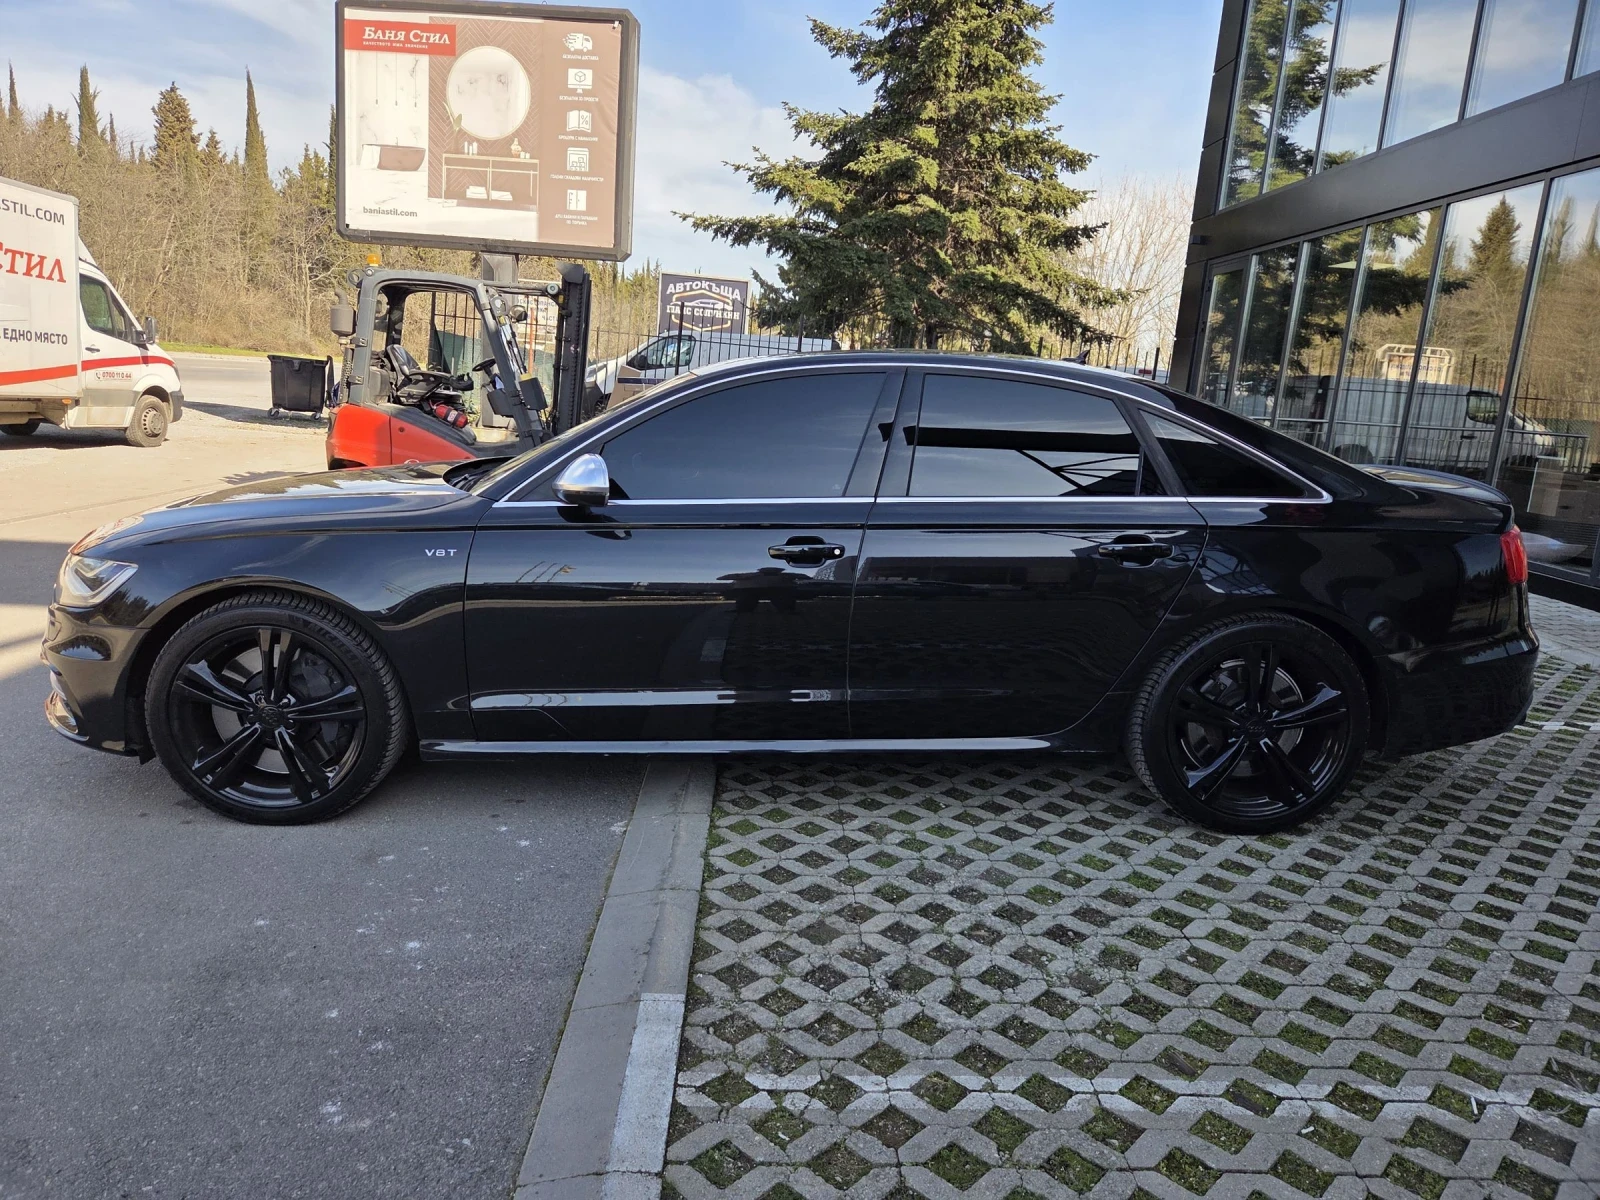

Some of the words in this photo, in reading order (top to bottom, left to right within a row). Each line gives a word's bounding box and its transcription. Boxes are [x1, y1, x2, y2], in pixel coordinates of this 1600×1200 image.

[0, 199, 65, 226] STIL.COM
[362, 206, 418, 217] baniastil.com
[666, 280, 741, 301] АВТОКЪЩА
[3, 327, 33, 343] ЕДНО
[34, 331, 68, 345] МЯСТО
